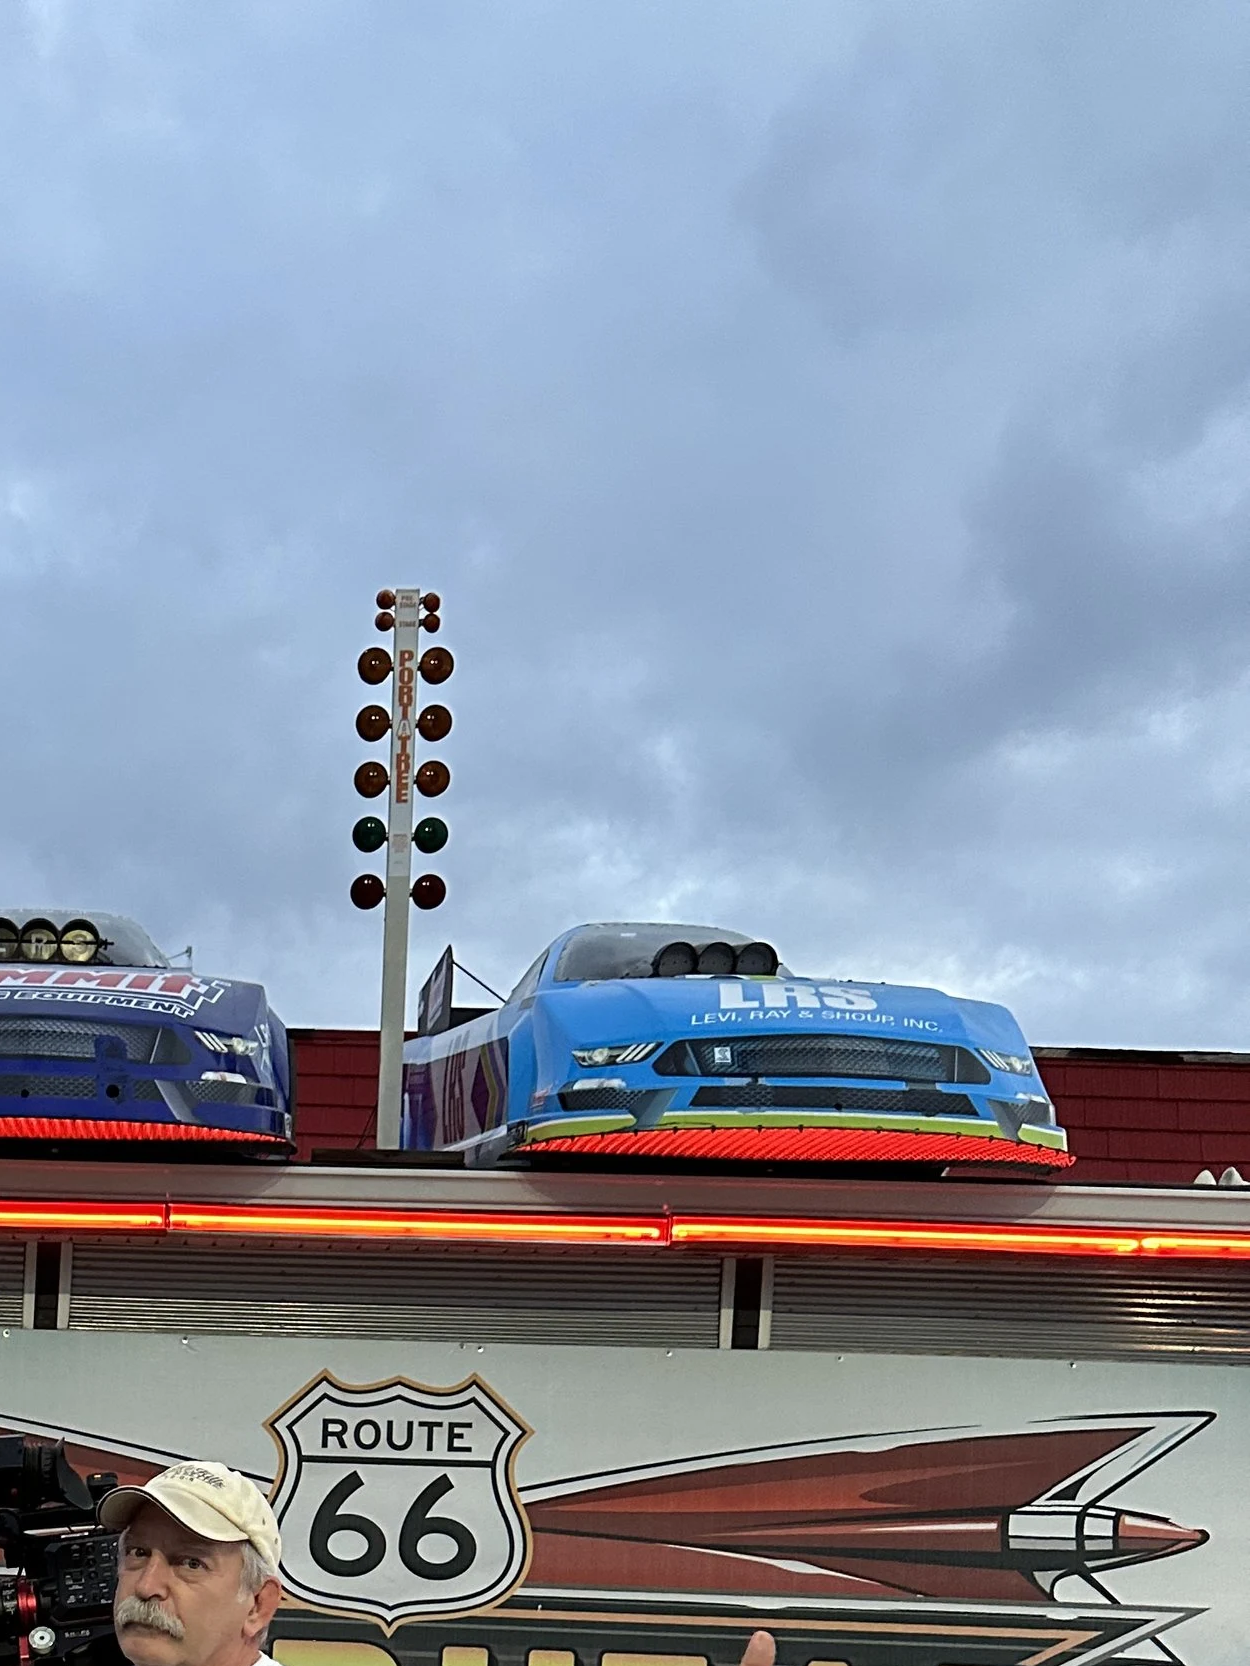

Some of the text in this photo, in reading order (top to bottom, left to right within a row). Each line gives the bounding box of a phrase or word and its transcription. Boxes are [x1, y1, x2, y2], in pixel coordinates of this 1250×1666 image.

[14, 990, 196, 1019] EQUIPMENT
[719, 983, 878, 1011] LRS
[691, 1010, 944, 1033] LEVI, RAY & SHOUP, INC.
[321, 1418, 474, 1454] ROUTE
[309, 1470, 477, 1581] 66
